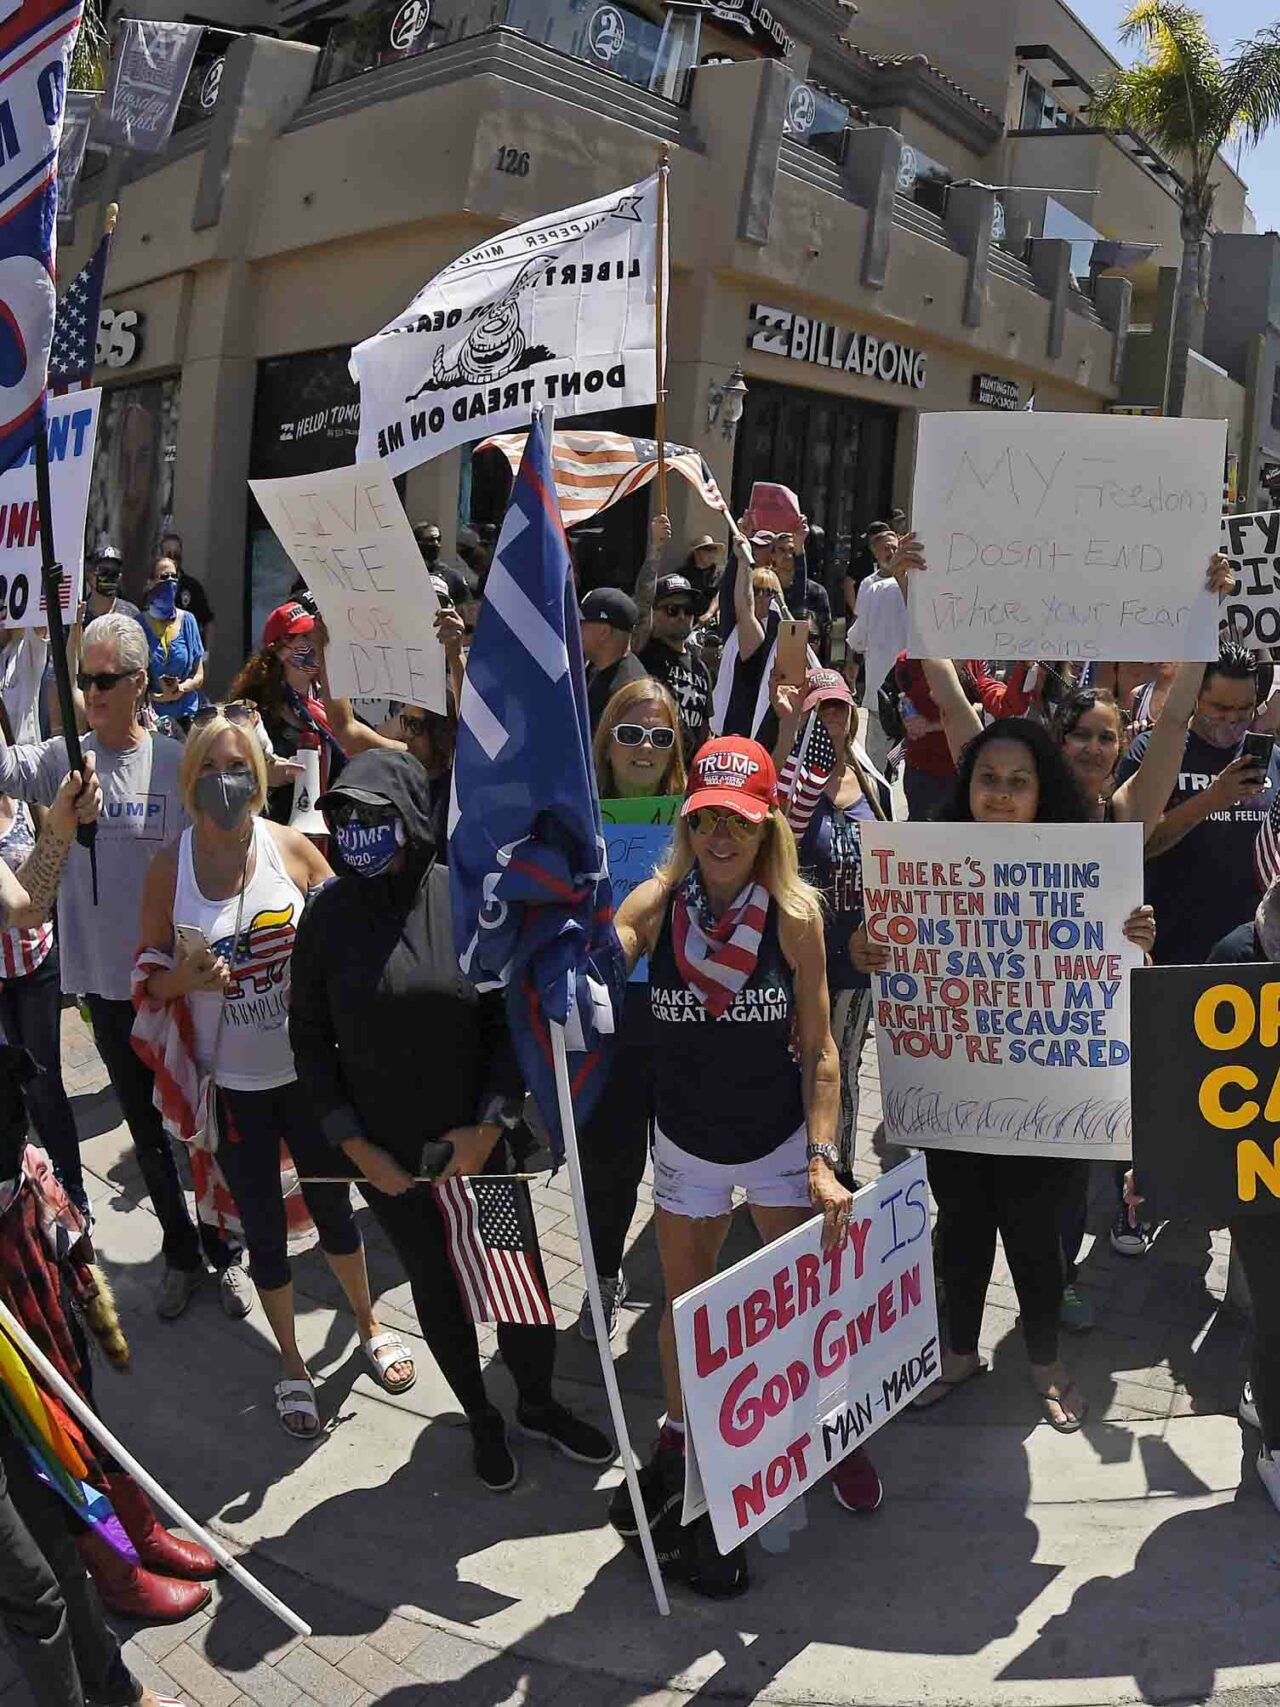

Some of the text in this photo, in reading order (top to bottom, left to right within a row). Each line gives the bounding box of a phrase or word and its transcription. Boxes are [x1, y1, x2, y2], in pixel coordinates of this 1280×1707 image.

[496, 145, 531, 178] 126
[790, 314, 927, 390] BILLABONG
[295, 409, 329, 441] HELLO!
[945, 446, 1069, 518] MY
[278, 484, 393, 536] LIVE
[293, 545, 396, 592] FREE
[1119, 599, 1195, 628] Fear
[349, 643, 428, 704] DIE
[697, 753, 760, 776] TRUMP
[870, 849, 1100, 889] THERE'S NOTHING
[864, 887, 1085, 918] WRITTEN IN THE
[867, 912, 1105, 951] CONSTITUTION
[1034, 954, 1041, 980] I
[1054, 954, 1123, 981] HAVE
[651, 986, 699, 1003] MAKE
[876, 970, 1121, 1010] TO FORFEIT MY
[651, 1004, 788, 1022] GREAT AGAIN!
[976, 1008, 1107, 1036] BECAUSE
[886, 1028, 1131, 1068] YOU'RE SCARED
[693, 1178, 927, 1379] LIBERTY IS
[718, 1261, 923, 1448] GOD GIVEN
[730, 1335, 938, 1530] NOT MAN-MADE
